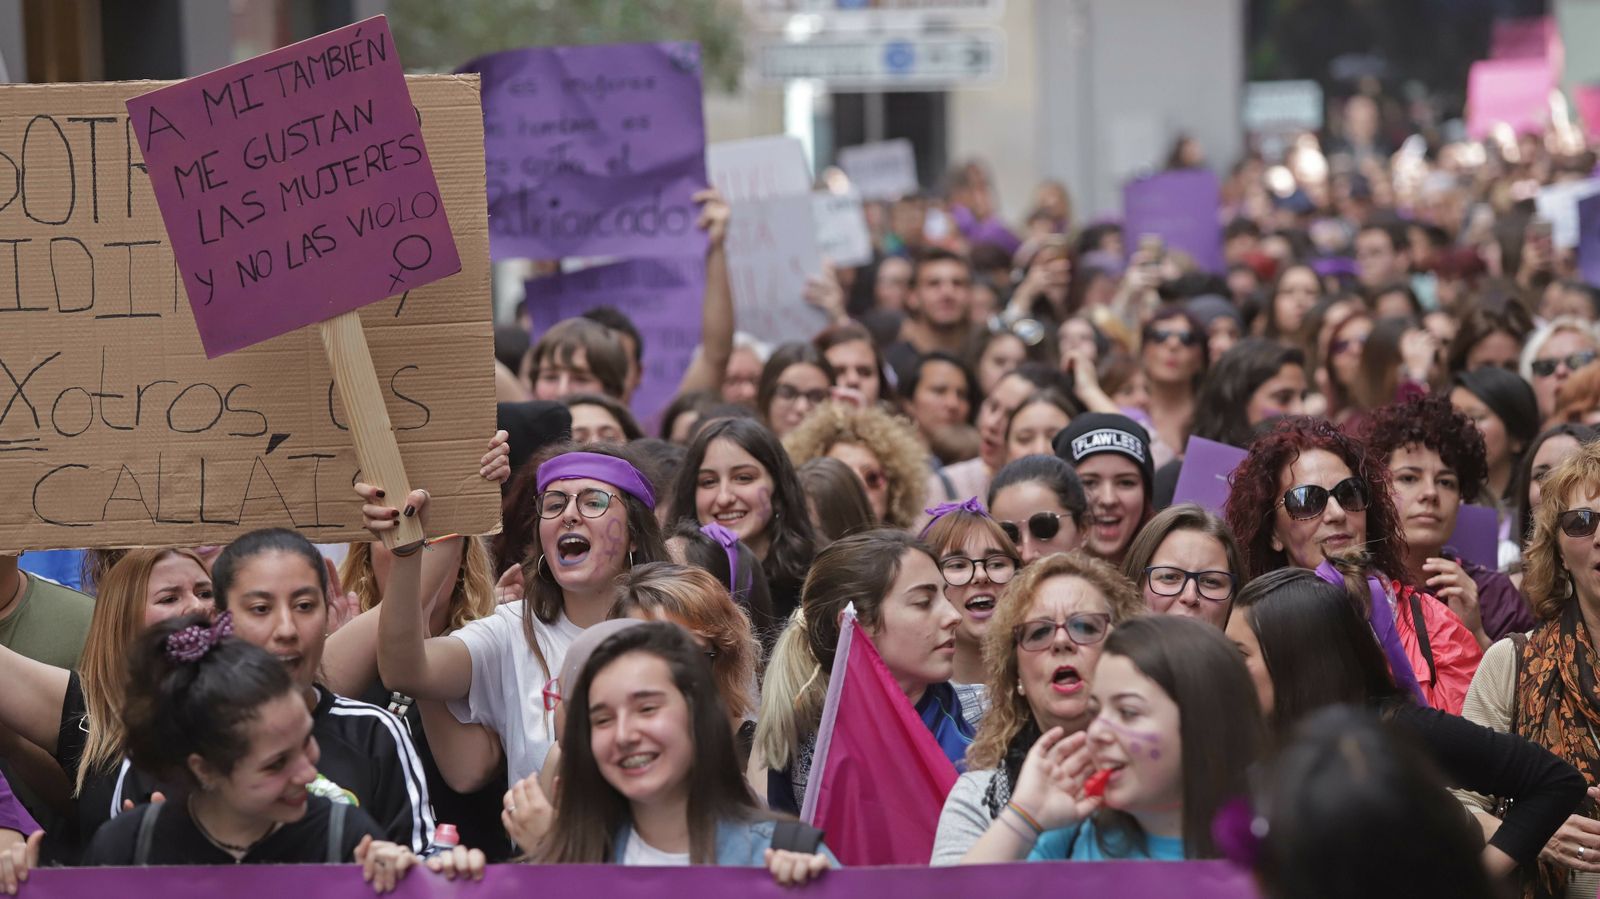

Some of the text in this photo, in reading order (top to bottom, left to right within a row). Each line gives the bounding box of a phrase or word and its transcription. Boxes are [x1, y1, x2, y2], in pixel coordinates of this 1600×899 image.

[147, 28, 386, 152] A MI TAMBIÉN
[174, 99, 373, 199] ME GUSTAN
[197, 134, 422, 244] LAS MUJERES
[236, 249, 272, 288] NO
[286, 223, 337, 270] LAS
[346, 191, 438, 238] VIOLO
[1076, 433, 1143, 454] FLAWLESS
